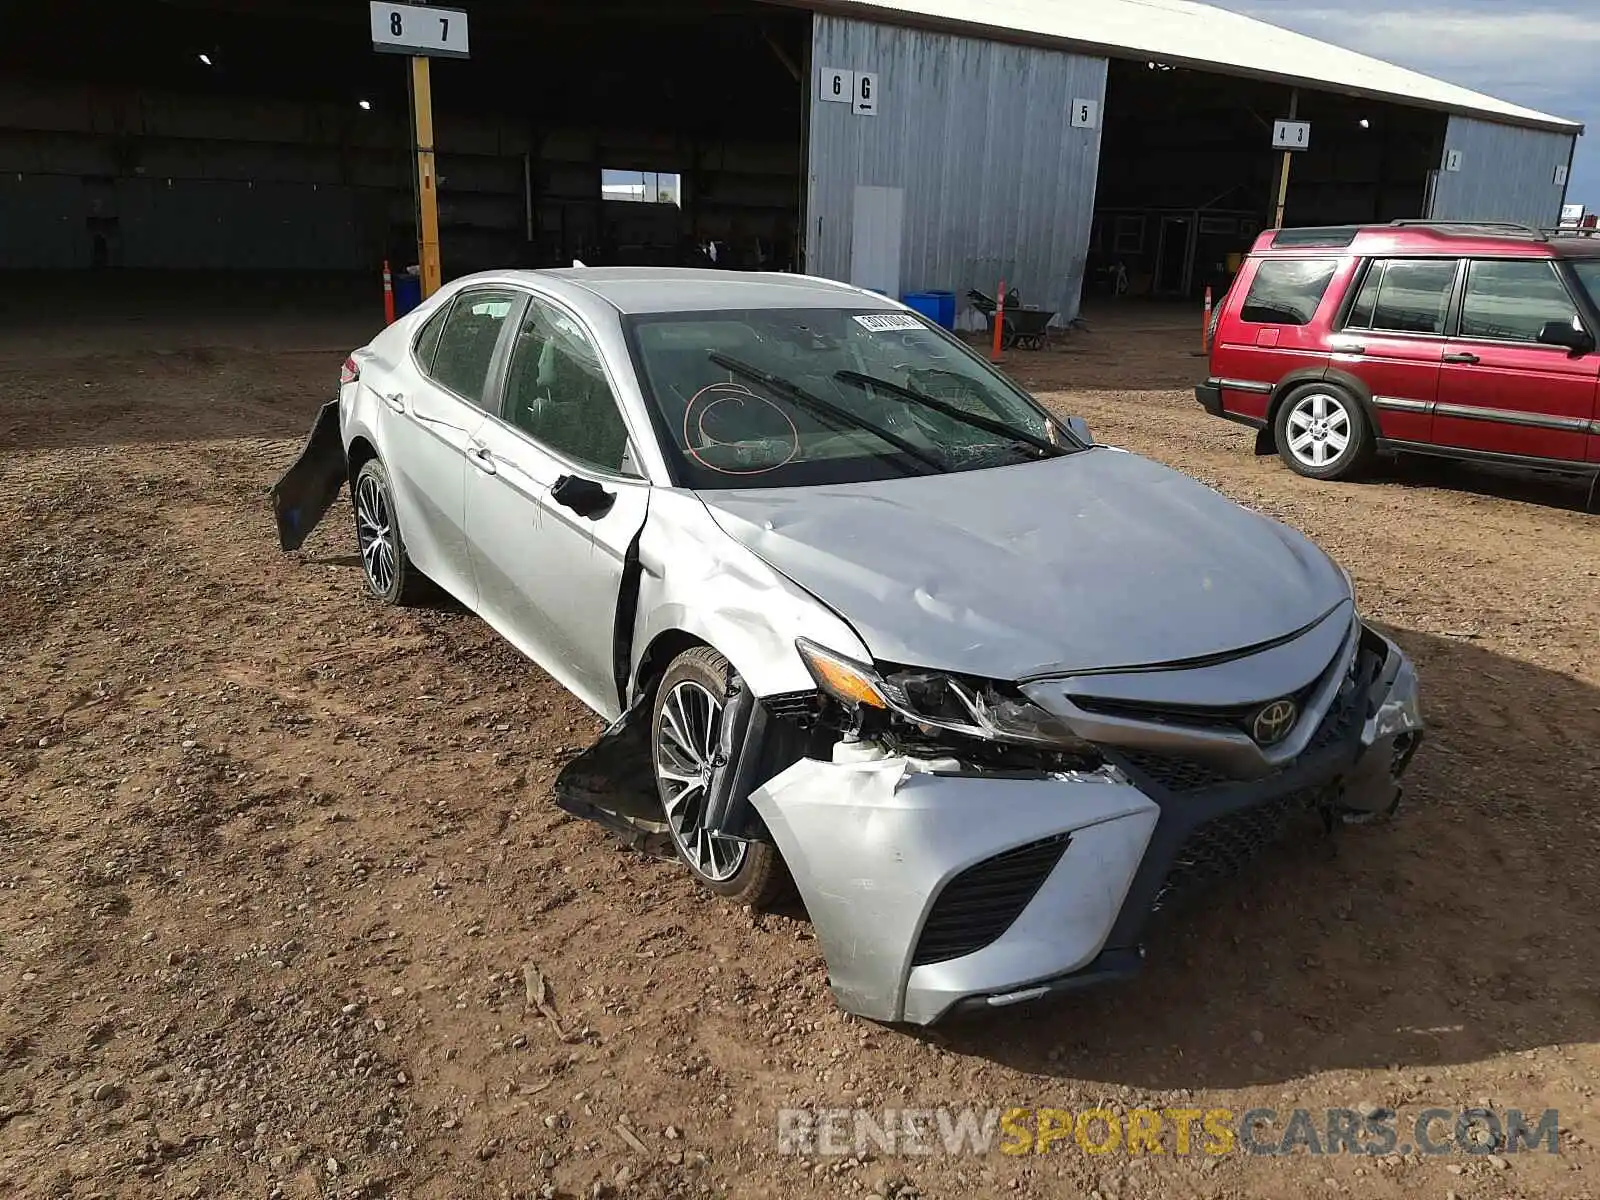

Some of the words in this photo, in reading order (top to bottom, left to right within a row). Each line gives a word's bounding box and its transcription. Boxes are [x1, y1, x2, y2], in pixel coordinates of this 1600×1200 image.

[390, 12, 402, 36] 8
[439, 18, 449, 41] 7
[833, 75, 841, 95] 6
[861, 77, 871, 99] G
[1081, 105, 1088, 122] 5
[1280, 127, 1286, 142] 4
[1297, 127, 1303, 142] 3
